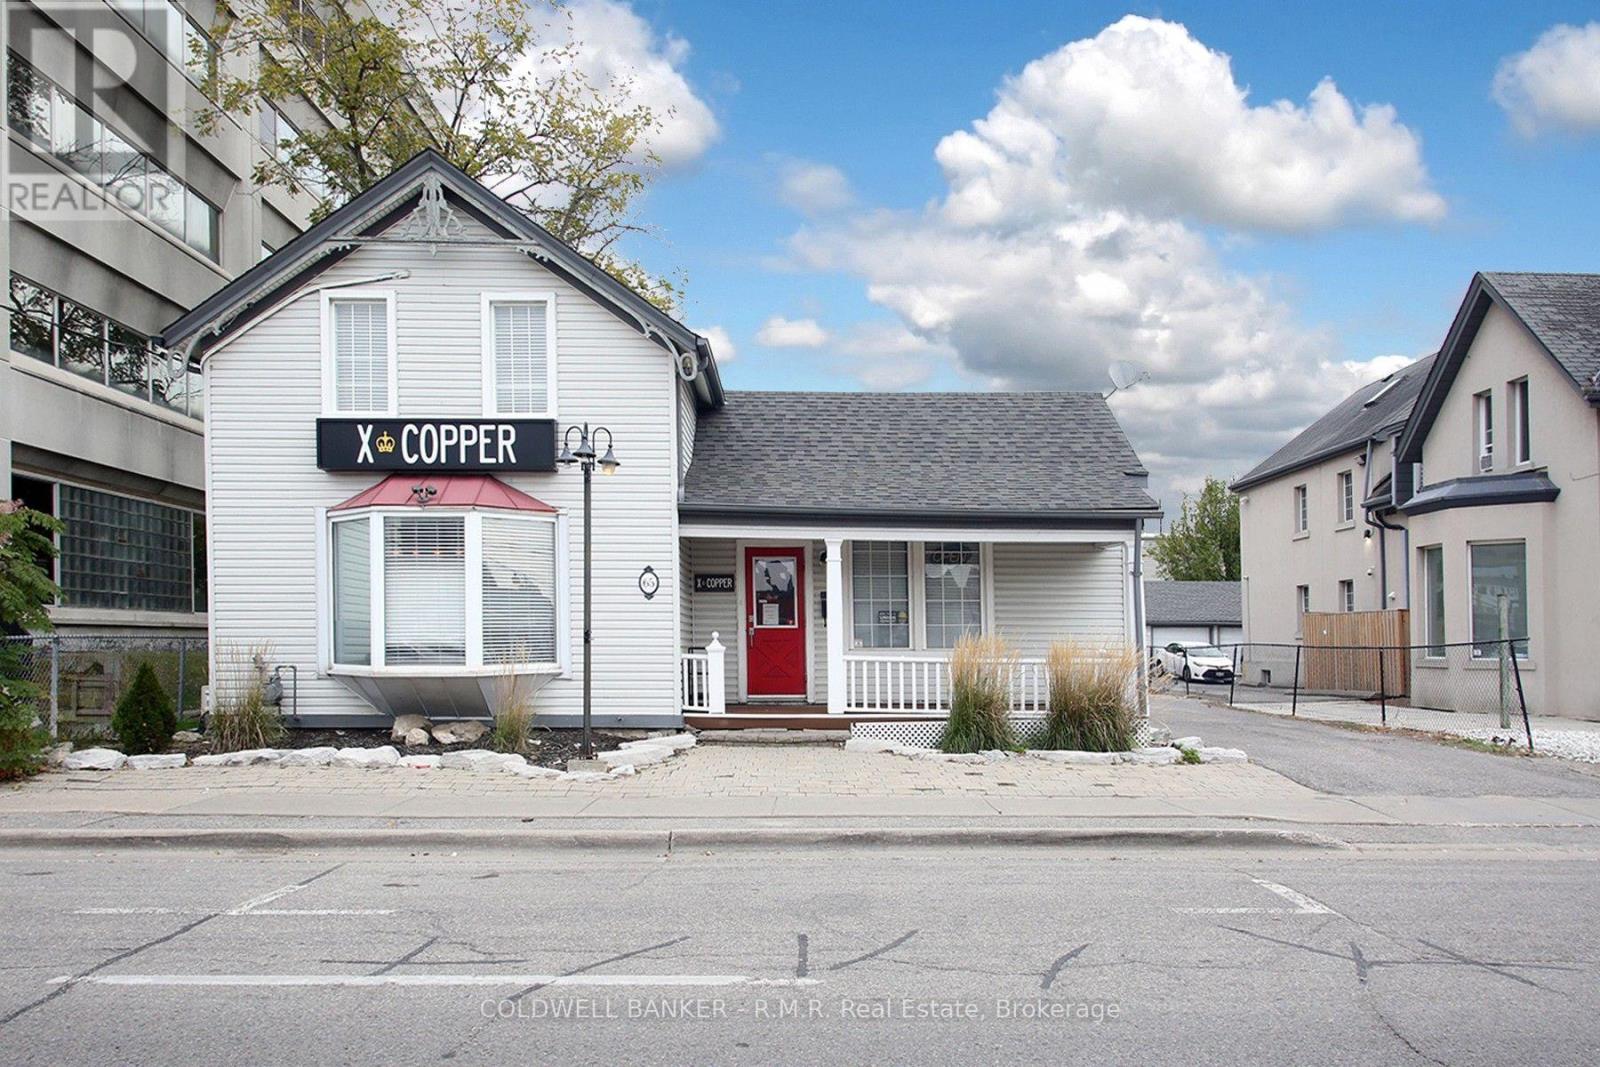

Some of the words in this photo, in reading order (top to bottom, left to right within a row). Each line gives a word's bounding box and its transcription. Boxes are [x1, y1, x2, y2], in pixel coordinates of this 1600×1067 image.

[357, 424, 374, 463] X
[402, 424, 516, 464] COPPER
[706, 578, 732, 588] COPPER
